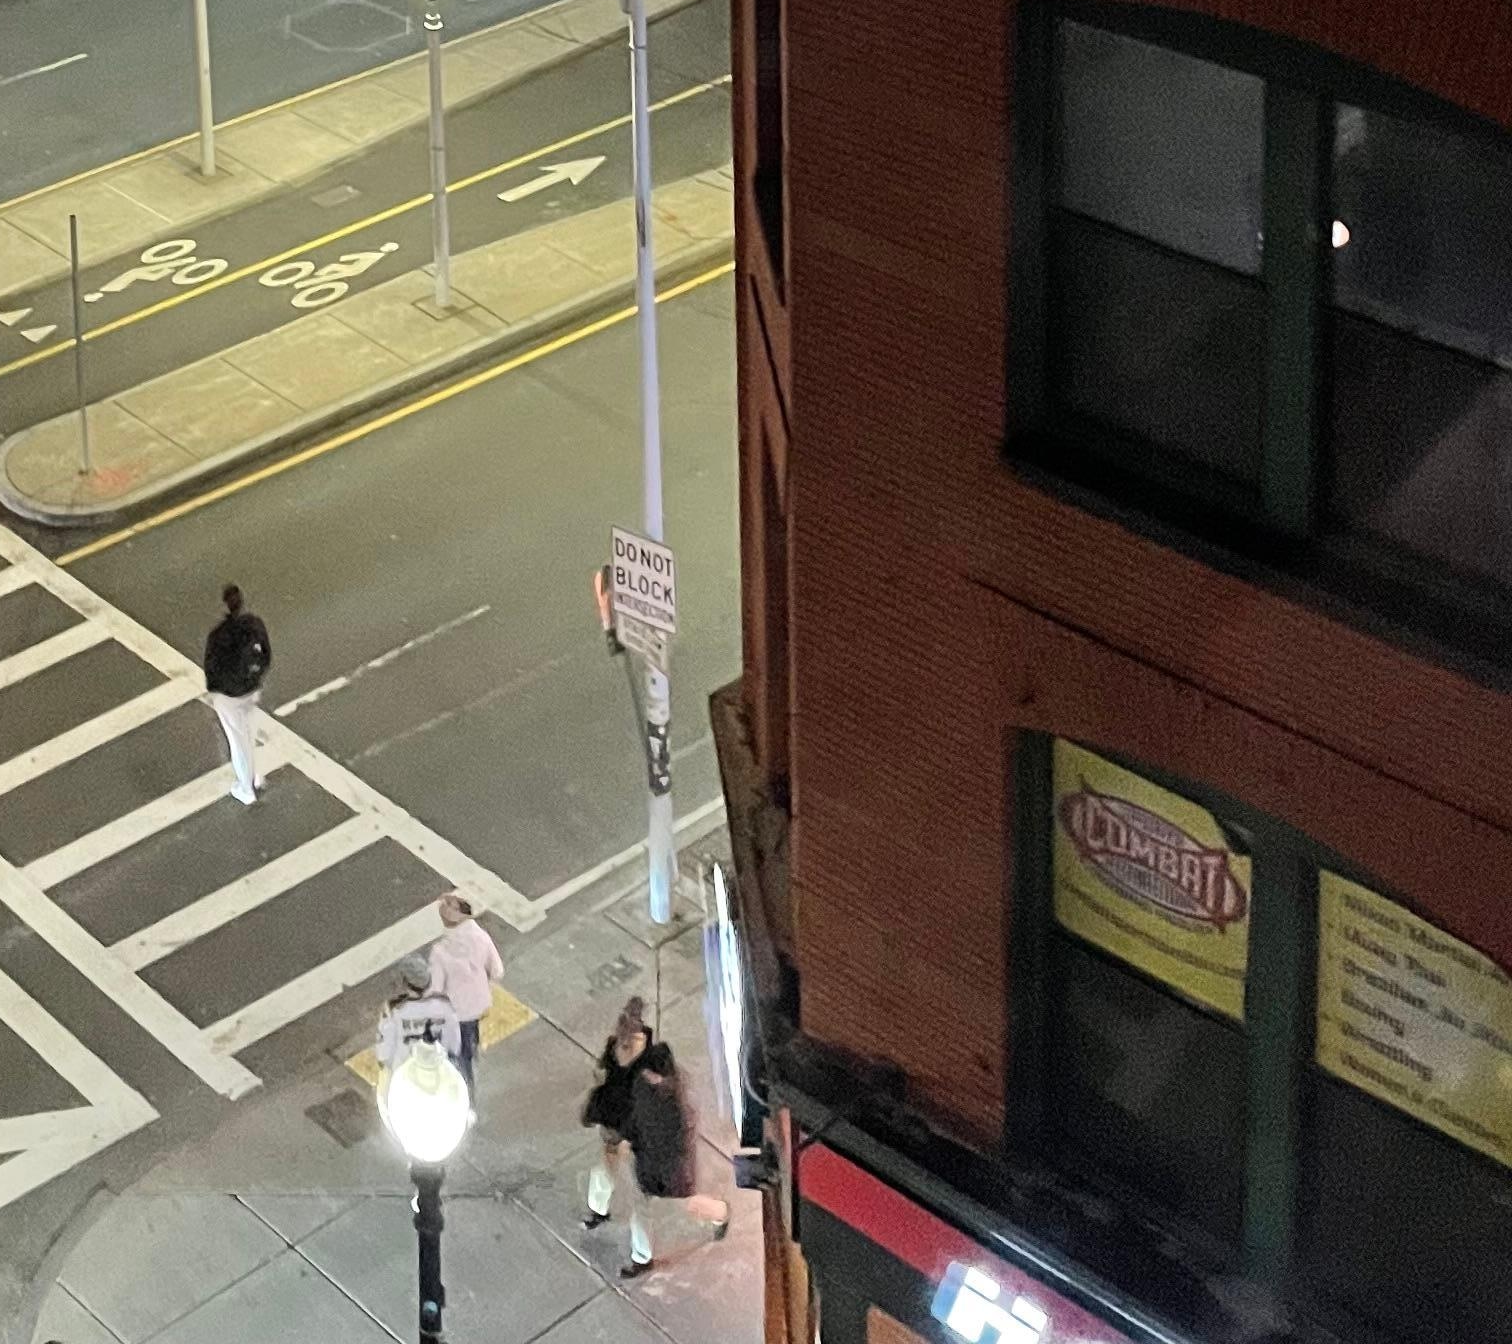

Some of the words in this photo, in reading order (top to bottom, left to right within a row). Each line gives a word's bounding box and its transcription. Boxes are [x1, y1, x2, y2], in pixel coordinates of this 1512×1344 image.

[615, 537, 637, 562] DO
[639, 548, 672, 577] NOT
[615, 565, 674, 606] BLOCK
[1088, 794, 1228, 909] COMBAT
